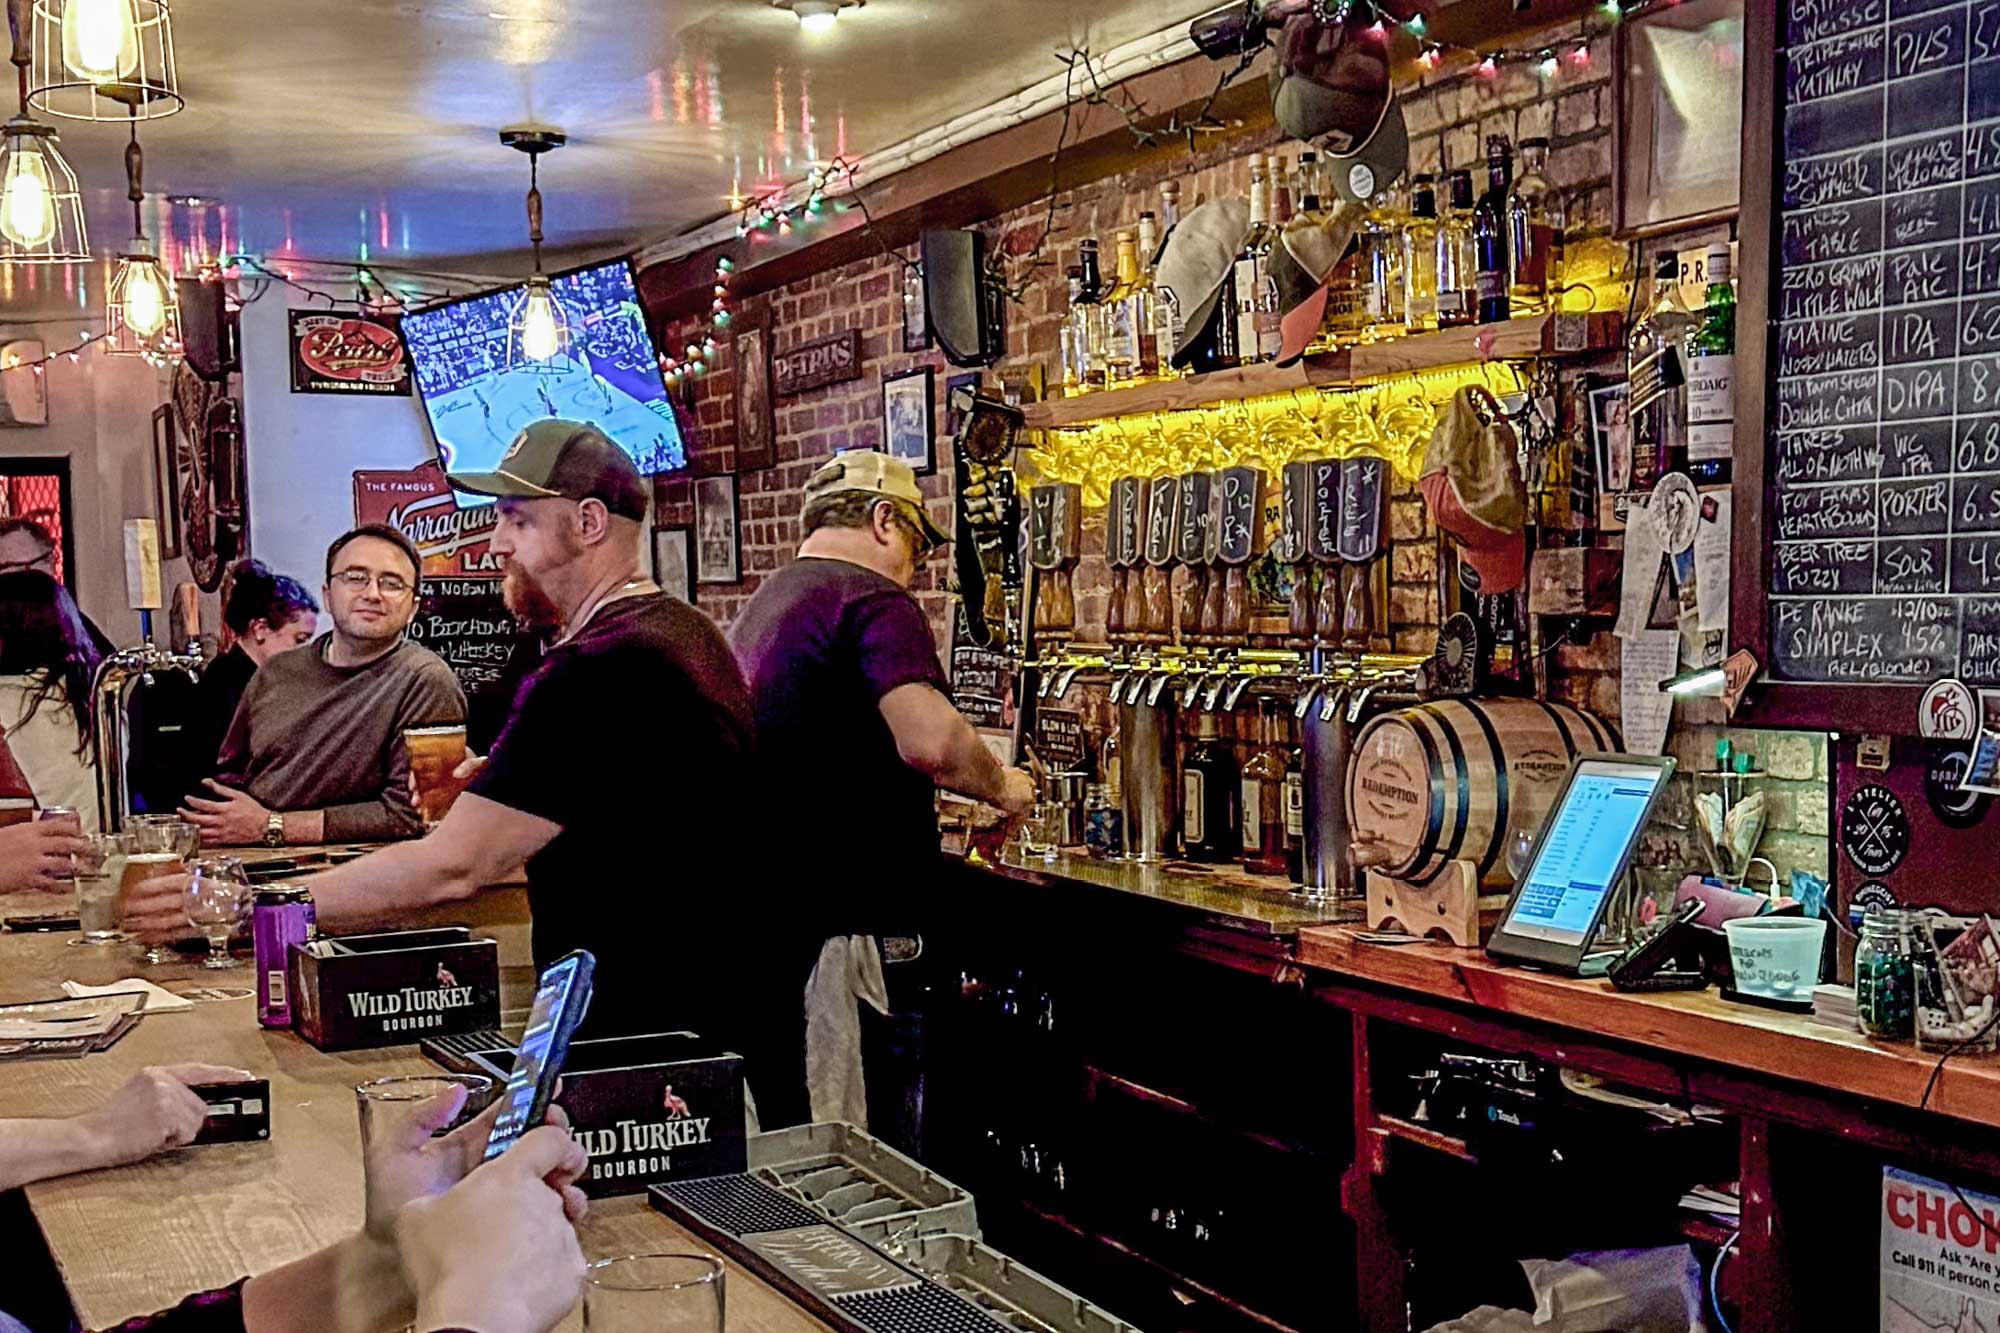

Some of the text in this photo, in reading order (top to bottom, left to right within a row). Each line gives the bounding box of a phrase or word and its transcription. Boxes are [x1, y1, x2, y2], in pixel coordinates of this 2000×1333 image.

[1893, 25, 1951, 75] PILS
[1806, 227, 1862, 261] TABLE
[1784, 289, 1840, 320] LITTLE
[1785, 316, 1858, 350] MAINE
[1892, 313, 1940, 358] IPA
[1887, 369, 1945, 414] DIPA
[1779, 402, 1831, 429] Double
[1780, 430, 1845, 457] THREES
[1778, 456, 1804, 479] ALL
[1900, 453, 1933, 477] IPA
[366, 482, 435, 492] THE FAMOUS
[1880, 482, 1947, 522] PORTER
[1033, 493, 1050, 550] WIT
[1778, 541, 1874, 567] BEER TREE
[1885, 545, 1934, 581] SOUR
[1787, 564, 1841, 591] FUZZY
[1812, 599, 1865, 636] RANKE
[448, 640, 516, 664] WHISKEY
[1790, 627, 1883, 660] SIMPLEX
[348, 986, 474, 1018] WILD TURKEY
[383, 1014, 443, 1031] BOURBON
[616, 1117, 711, 1153] TURKEY
[592, 1155, 671, 1179] BOURBON
[1892, 1250, 1915, 1268] Call
[1918, 1257, 1935, 1274] 911
[1938, 1265, 1945, 1277] if
[1949, 1268, 1990, 1292] person
[1940, 1247, 1961, 1265] Ask
